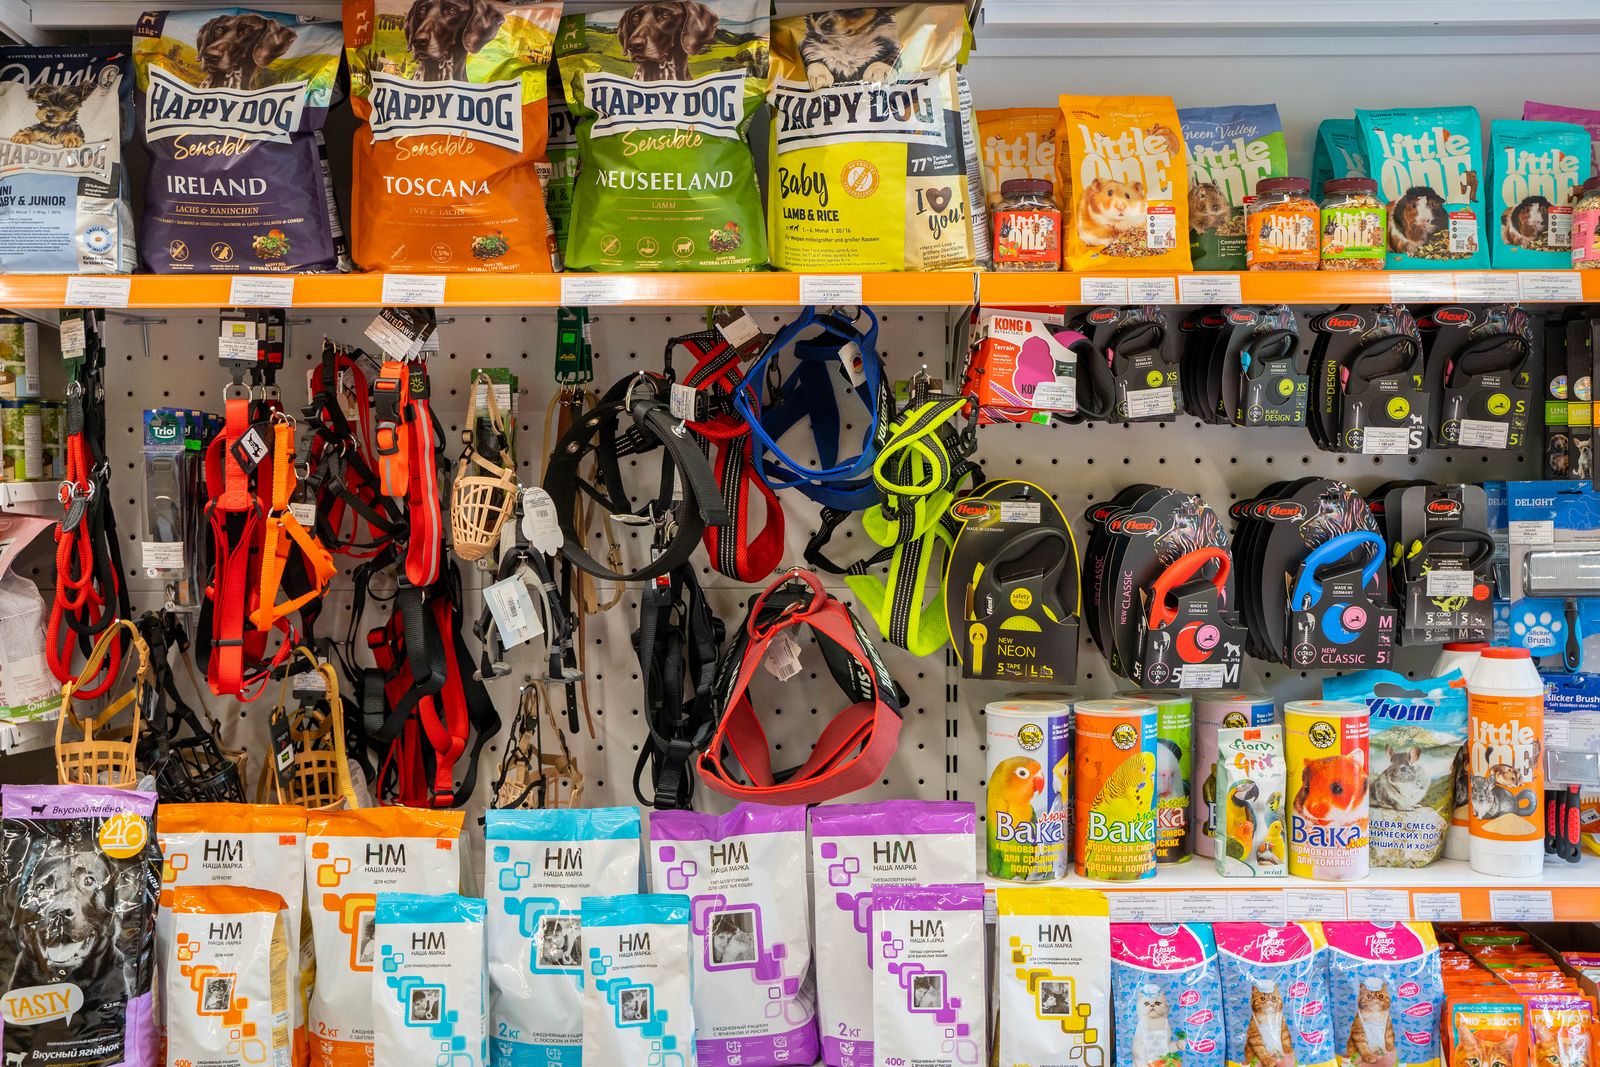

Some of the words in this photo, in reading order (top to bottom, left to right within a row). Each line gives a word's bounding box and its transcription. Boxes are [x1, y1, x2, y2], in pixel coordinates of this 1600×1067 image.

[150, 83, 243, 124] HAPPY
[238, 93, 295, 132] DOG
[374, 87, 452, 125] HAPPY
[457, 91, 514, 132] DOG
[591, 86, 675, 119] HAPPY
[683, 84, 736, 123] DOG
[774, 89, 863, 133] HAPPY
[868, 82, 935, 126] DOG
[1181, 123, 1216, 141] Green
[1216, 124, 1260, 140] Valley
[174, 131, 250, 161] Sensible
[395, 130, 476, 161] Sensible
[623, 125, 703, 158] Sensible
[1077, 124, 1169, 160] little
[1373, 126, 1471, 162] little
[0, 143, 64, 166] HAPPY
[65, 144, 107, 170] DOG
[1504, 148, 1580, 178] little
[166, 175, 267, 196] IRELAND
[383, 175, 491, 198] TOSCANA
[595, 168, 733, 191] NEUSEELAND
[778, 162, 829, 208] Baby
[18, 196, 25, 206] &
[28, 195, 66, 206] JUNIOR
[175, 205, 200, 214] LACHS
[210, 206, 259, 215] KANINCHEN
[783, 207, 806, 221] LAMB
[807, 209, 816, 221] &
[817, 209, 840, 222] RICE
[928, 202, 966, 241] you!
[1328, 316, 1359, 328] flexi
[1436, 311, 1468, 322] flexi
[994, 317, 1024, 332] KONG
[993, 343, 1015, 351] Terrain
[1166, 371, 1178, 381] XS
[1326, 359, 1337, 396] DESIGN
[1296, 382, 1307, 392] XS
[1515, 400, 1526, 413] S
[1265, 413, 1291, 422] DESIGN
[1293, 410, 1301, 422] 3
[152, 425, 177, 437] Triol
[1409, 430, 1423, 449] S
[1508, 433, 1519, 446] 5
[1428, 503, 1456, 512] flexi
[1514, 498, 1555, 507] DELIGHT
[956, 505, 990, 516] flexi
[1269, 506, 1300, 516] flexi
[1125, 521, 1155, 532] flexi
[1012, 592, 1031, 602] safety
[1378, 615, 1393, 629] M
[1426, 613, 1434, 624] 5
[1461, 613, 1468, 624] S
[1458, 628, 1469, 638] M
[1527, 636, 1551, 645] Brush
[1528, 629, 1551, 637] Slicker
[997, 644, 1036, 658] NEON
[1320, 653, 1366, 664] CLASSIC
[1376, 651, 1386, 664] 5
[997, 662, 1005, 673] 5
[1006, 662, 1021, 670] TAPE
[1030, 665, 1038, 675] L
[1170, 667, 1183, 683] 5
[1221, 663, 1239, 683] M
[1546, 694, 1574, 703] Slicker
[1575, 695, 1600, 703] Brush
[1365, 698, 1434, 722] Уют
[1471, 716, 1536, 745] little
[1234, 752, 1274, 778] Grit
[52, 805, 89, 816] Вкусный
[995, 810, 1065, 844] Вака
[1088, 811, 1157, 844] Вака
[1161, 829, 1186, 838] смесь
[1291, 815, 1361, 848] Вака
[1406, 822, 1436, 830] СМЕСЬ
[203, 839, 243, 862] НМ
[365, 843, 407, 866] НМ
[709, 840, 750, 867] НМ
[873, 840, 917, 864] НМ
[1004, 853, 1021, 863] для
[202, 862, 222, 870] НАША
[544, 847, 583, 870] НМ
[1094, 853, 1112, 863] для
[1114, 853, 1148, 864] мелких
[1296, 855, 1313, 866] для
[364, 866, 385, 874] НАША
[728, 864, 750, 873] МАРКА
[1011, 864, 1053, 874] попугаев
[1086, 862, 1125, 872] средних
[208, 921, 243, 941] НМ
[909, 919, 945, 938] НМ
[1038, 924, 1073, 943] НМ
[411, 931, 446, 950] НМ
[619, 931, 651, 953] НМ
[1370, 946, 1396, 957] Котов
[6, 987, 72, 1019] TASTY
[318, 1021, 328, 1036] 2
[327, 1027, 340, 1038] кг
[498, 1022, 508, 1038] 2
[508, 1029, 521, 1040] кг
[838, 1022, 848, 1037] 2
[849, 1028, 861, 1038] кг
[32, 1049, 78, 1061] Вкусный
[78, 1042, 120, 1058] ягнёнок
[885, 1057, 905, 1067] 400г
